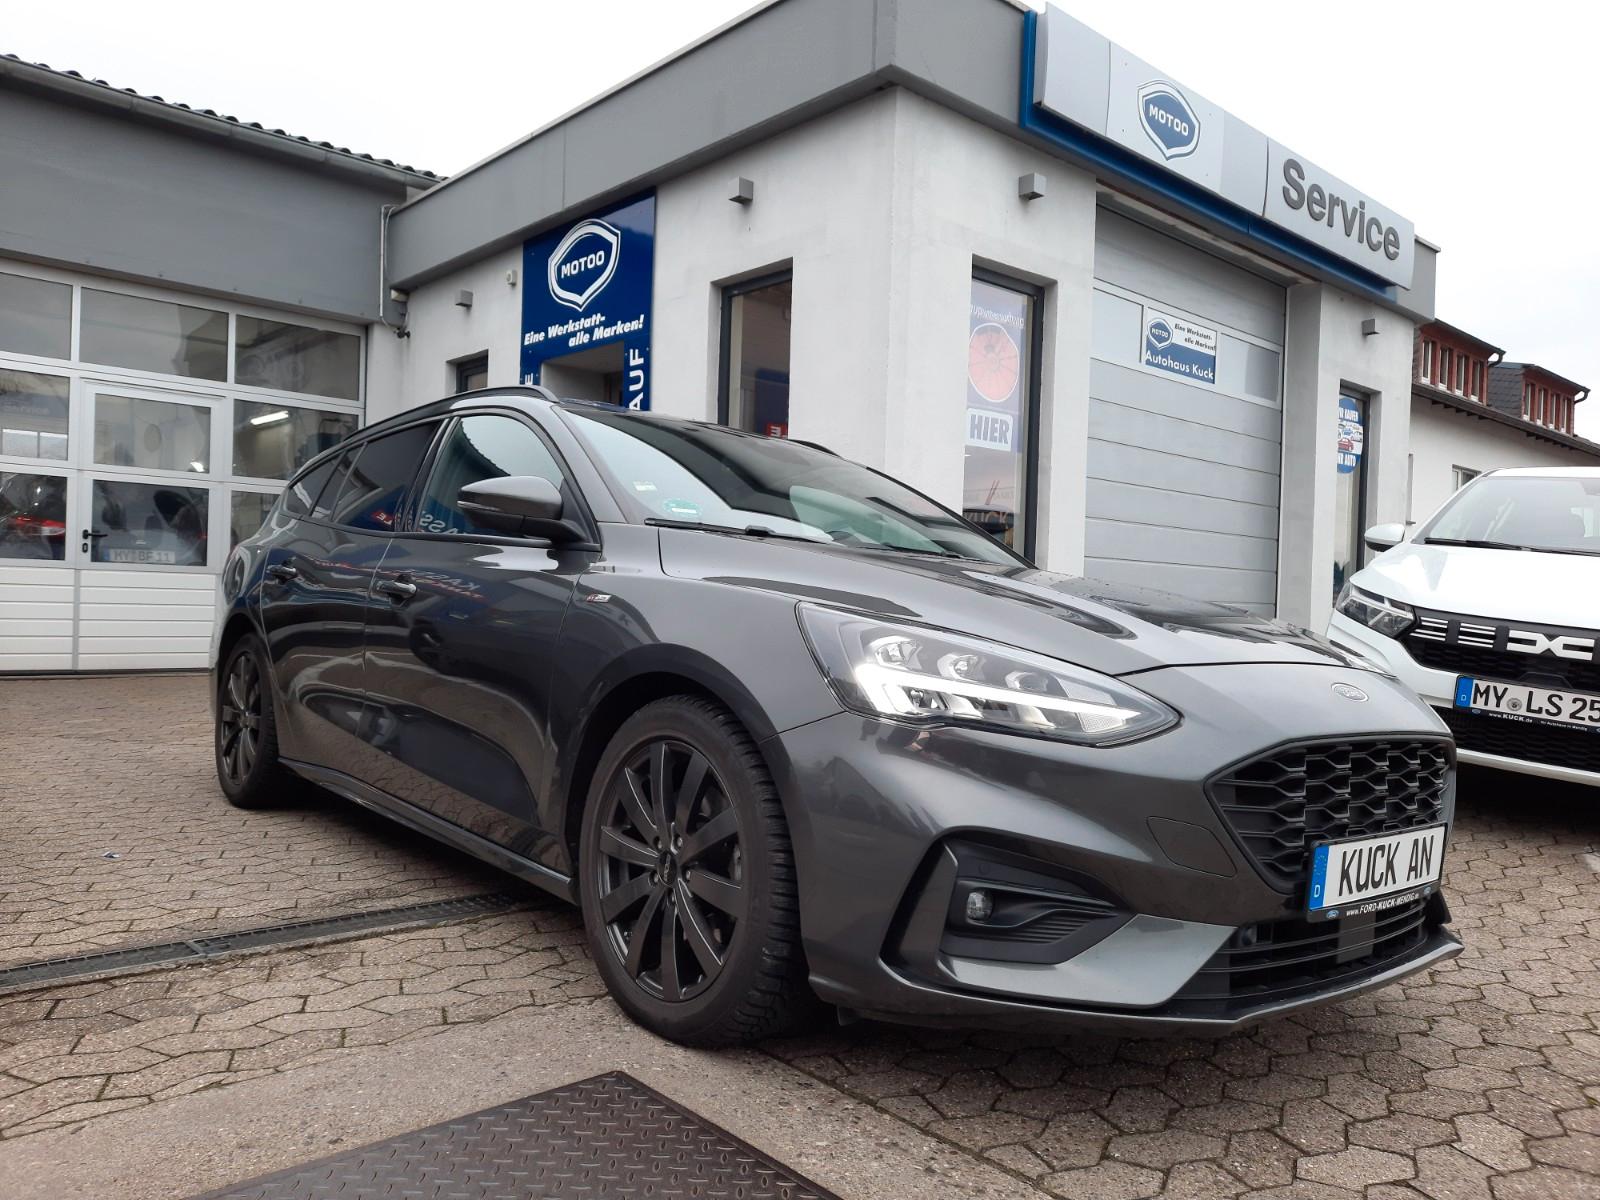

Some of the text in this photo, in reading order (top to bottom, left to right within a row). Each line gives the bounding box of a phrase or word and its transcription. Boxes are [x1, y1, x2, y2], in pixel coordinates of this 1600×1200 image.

[1149, 104, 1189, 137] MOTOO
[1282, 158, 1400, 261] Service
[561, 250, 605, 279] MOTOO
[524, 313, 606, 346] Eine Werkstatt-
[568, 314, 645, 348] alle Marken!
[1151, 327, 1169, 339] MOTOO
[1145, 350, 1214, 380] Autohaus Kuck
[969, 413, 1010, 445] HIER
[1472, 683, 1600, 722] MY LS 25
[1339, 835, 1435, 897] KUCK AN
[1313, 885, 1321, 898] D
